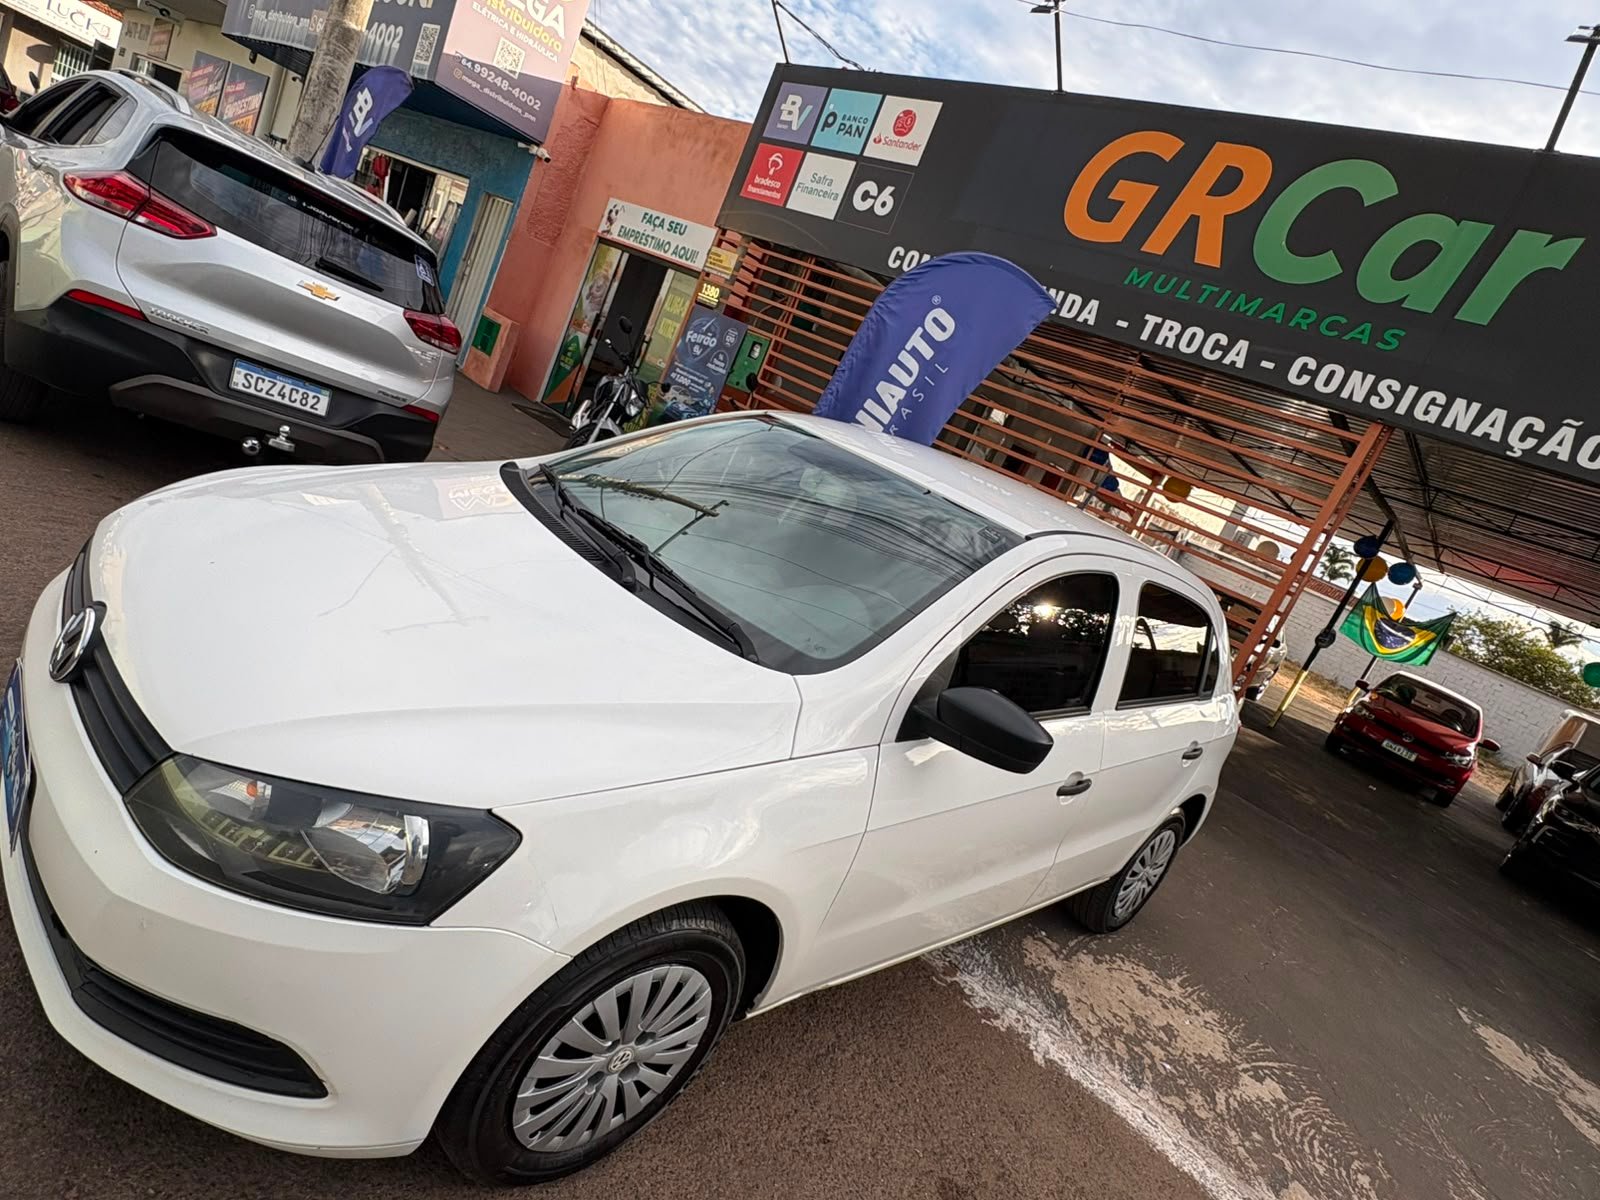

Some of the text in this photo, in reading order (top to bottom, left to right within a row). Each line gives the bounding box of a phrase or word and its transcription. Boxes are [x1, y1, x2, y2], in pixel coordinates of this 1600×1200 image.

[472, 2, 559, 62] ELÉTRICA E HIDRÁULICA
[461, 57, 541, 111] 64.99248-4002
[836, 123, 866, 139] PAN
[841, 113, 869, 125] BANCO
[882, 136, 922, 152] Santander
[796, 182, 839, 202] Financeira
[810, 172, 834, 188] Safra
[852, 180, 896, 217] C6
[641, 211, 688, 236] FAÇA SEU
[617, 225, 672, 254] EMPRÉSTIMO
[1124, 267, 1406, 351] MULTIMARCAS
[686, 330, 717, 347] Feirão
[241, 373, 321, 411] SCZ4C82
[1140, 314, 1250, 369] TROCA
[1287, 356, 1600, 470] CONSIGNAÇÃO
